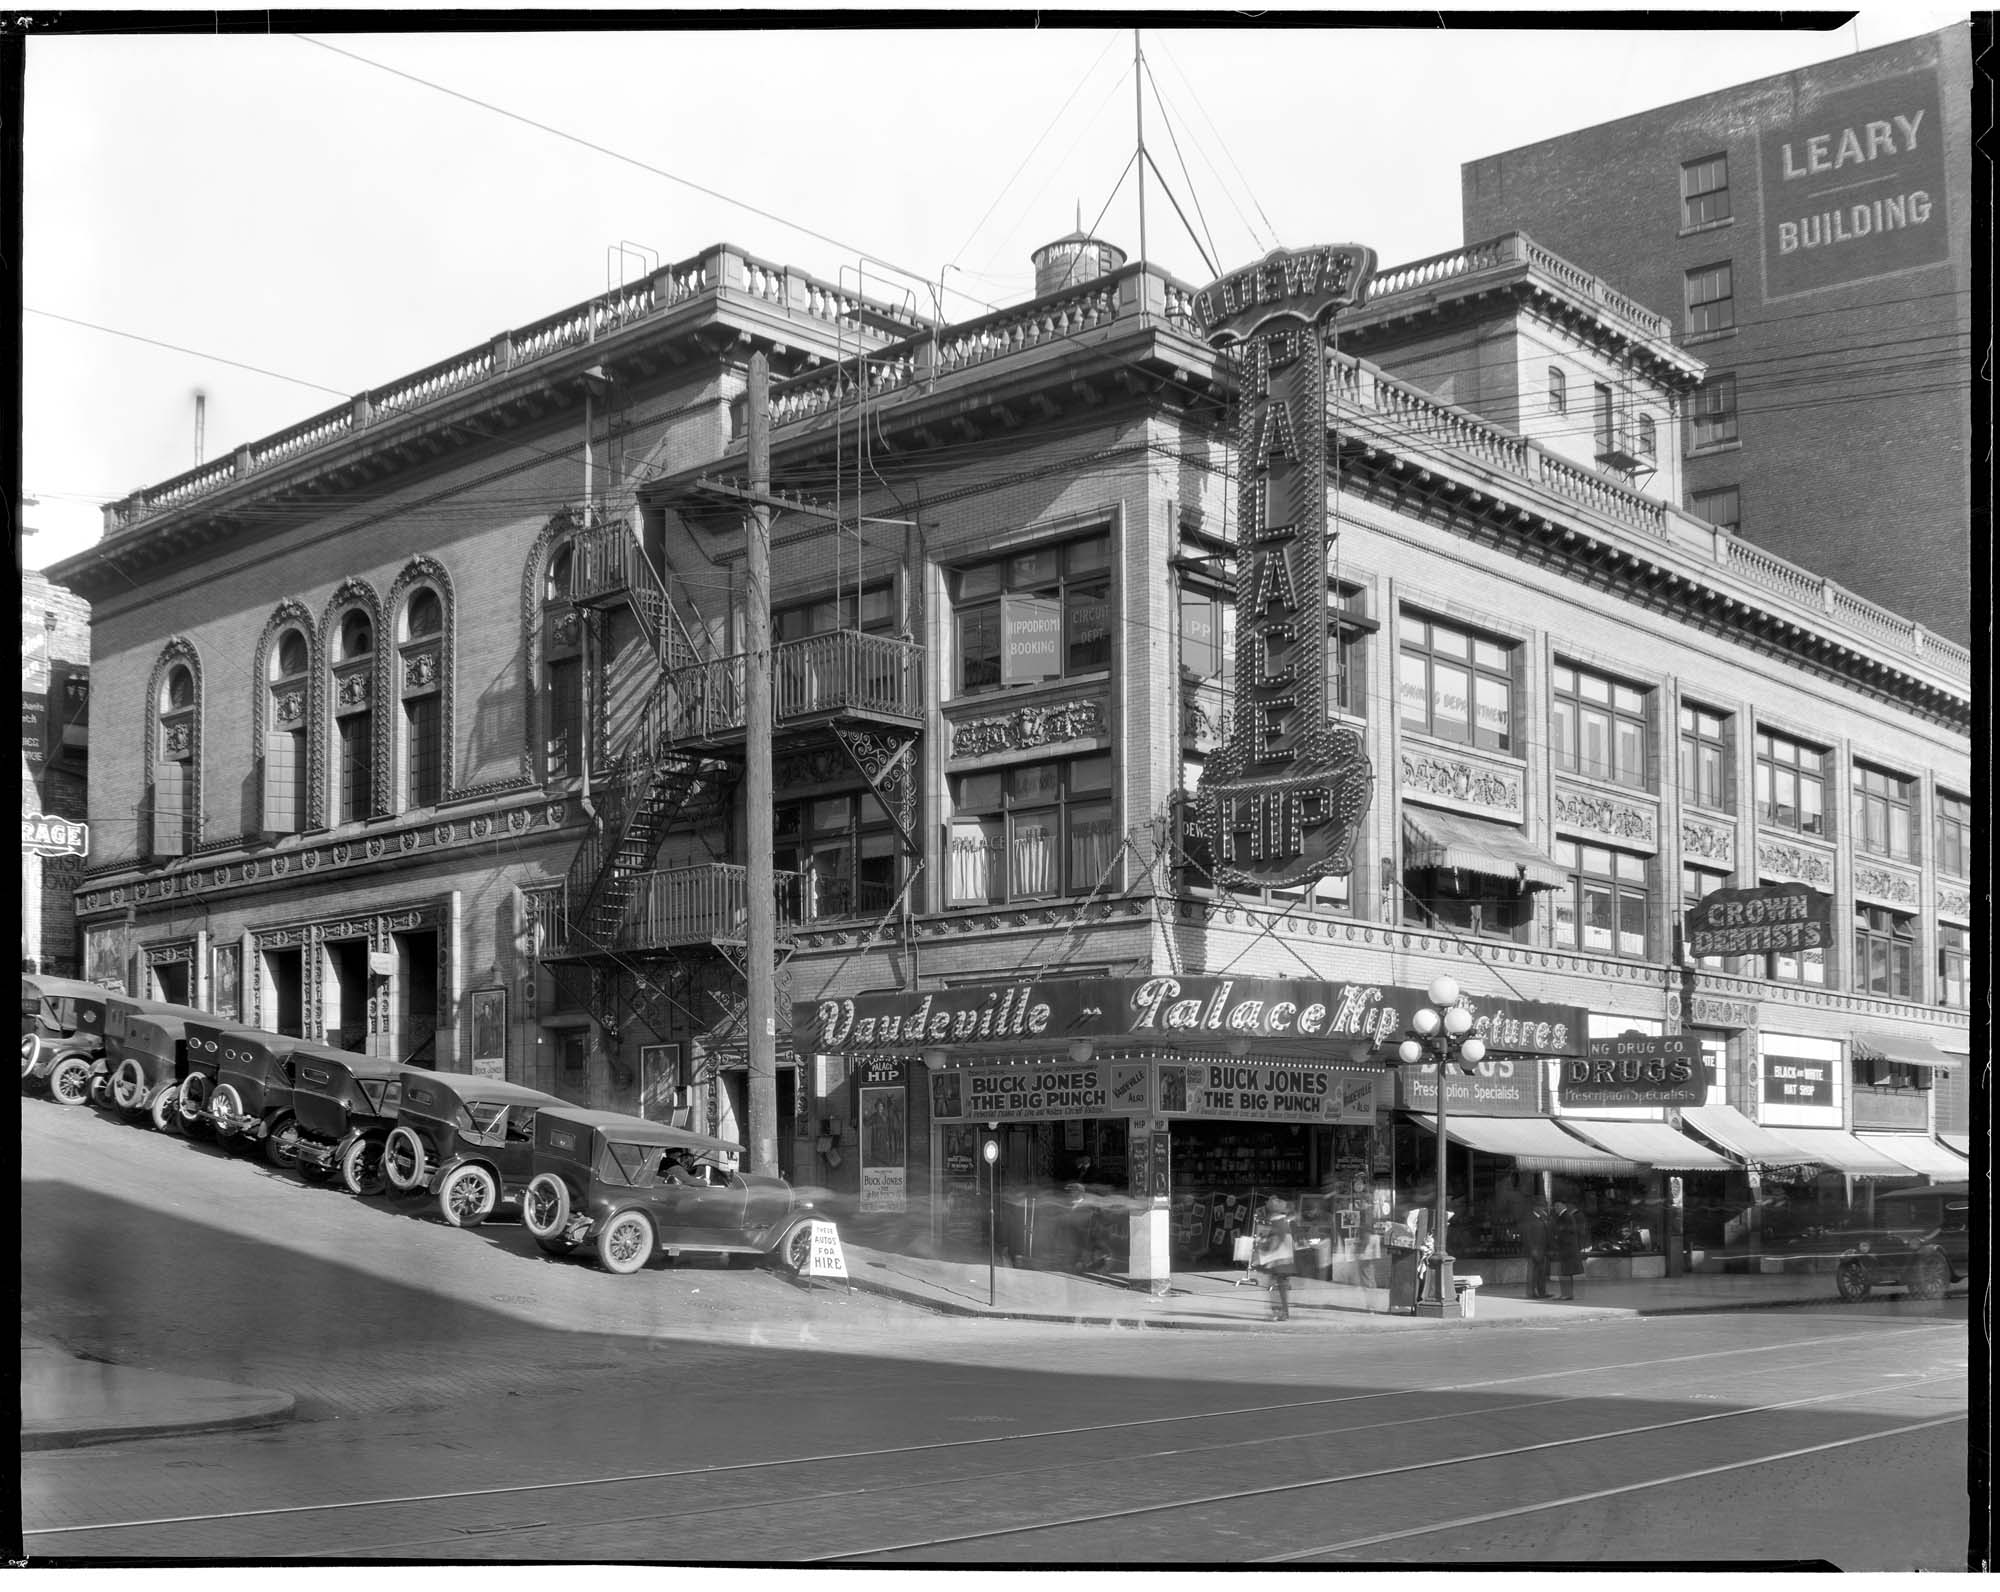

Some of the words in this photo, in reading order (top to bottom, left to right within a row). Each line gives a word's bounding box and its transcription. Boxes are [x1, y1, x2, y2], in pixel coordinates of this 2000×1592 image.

[1781, 109, 1926, 181] LEARY
[1778, 190, 1933, 256] BUILDING
[1254, 331, 1301, 766] PALACE
[1010, 640, 1055, 656] BOOKING
[1222, 787, 1334, 862] HIP
[1707, 895, 1808, 927] CROWN
[1694, 921, 1821, 952] DENTISTS
[818, 986, 1051, 1046] Vaudeville
[1131, 977, 1326, 1034] Palace
[1332, 984, 1399, 1051] Hip
[1617, 1042, 1656, 1054] DRUG
[1663, 1041, 1684, 1053] CO
[868, 1070, 899, 1081] HIP
[1209, 1065, 1260, 1090] BUCK
[1264, 1070, 1328, 1095] JONES
[1568, 1056, 1693, 1084] DRUGS
[1774, 1065, 1797, 1079] BLACK
[1804, 1068, 1824, 1081] WHITE
[972, 1075, 1026, 1094] BUCK
[1031, 1072, 1098, 1091] JONES
[1413, 1080, 1469, 1101] Prescption
[1474, 1083, 1520, 1103] Specialists
[1783, 1083, 1798, 1096] HAT
[1799, 1084, 1815, 1097] SHOP
[971, 1094, 1005, 1110] THE
[1010, 1093, 1043, 1109] BIG
[1046, 1090, 1106, 1107] PUNCH
[1204, 1091, 1234, 1108] THE
[1240, 1093, 1269, 1110] BIG
[1274, 1094, 1321, 1113] PUNCH
[1631, 1088, 1696, 1105] Specialists
[1134, 1119, 1146, 1128] HIP
[881, 1175, 903, 1186] JONES
[815, 1236, 837, 1246] AUTOS
[818, 1247, 835, 1255] FOR
[815, 1256, 842, 1270] HIRE
